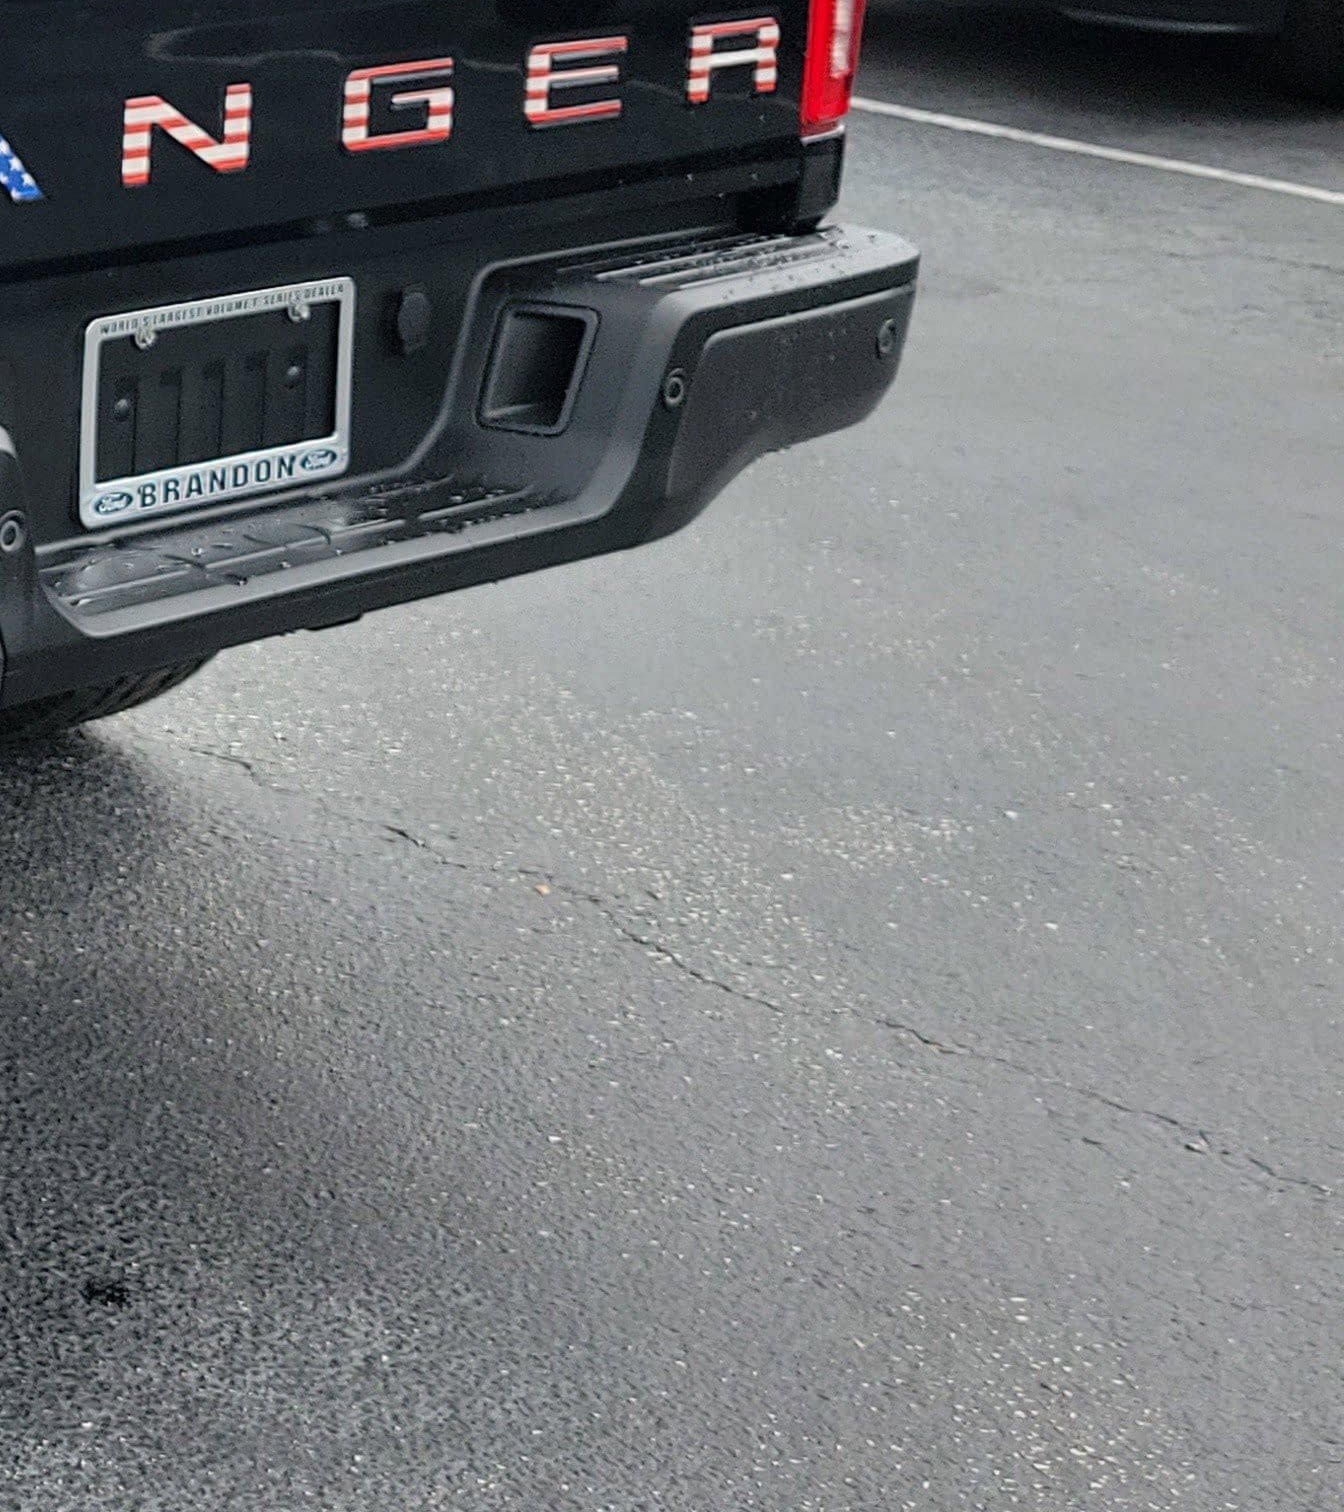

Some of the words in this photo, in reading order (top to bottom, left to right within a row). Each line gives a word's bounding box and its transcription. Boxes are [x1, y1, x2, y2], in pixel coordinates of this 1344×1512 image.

[99, 316, 150, 334] WORLDS
[153, 307, 201, 326] LARGEST
[138, 455, 296, 508] BRANDON
